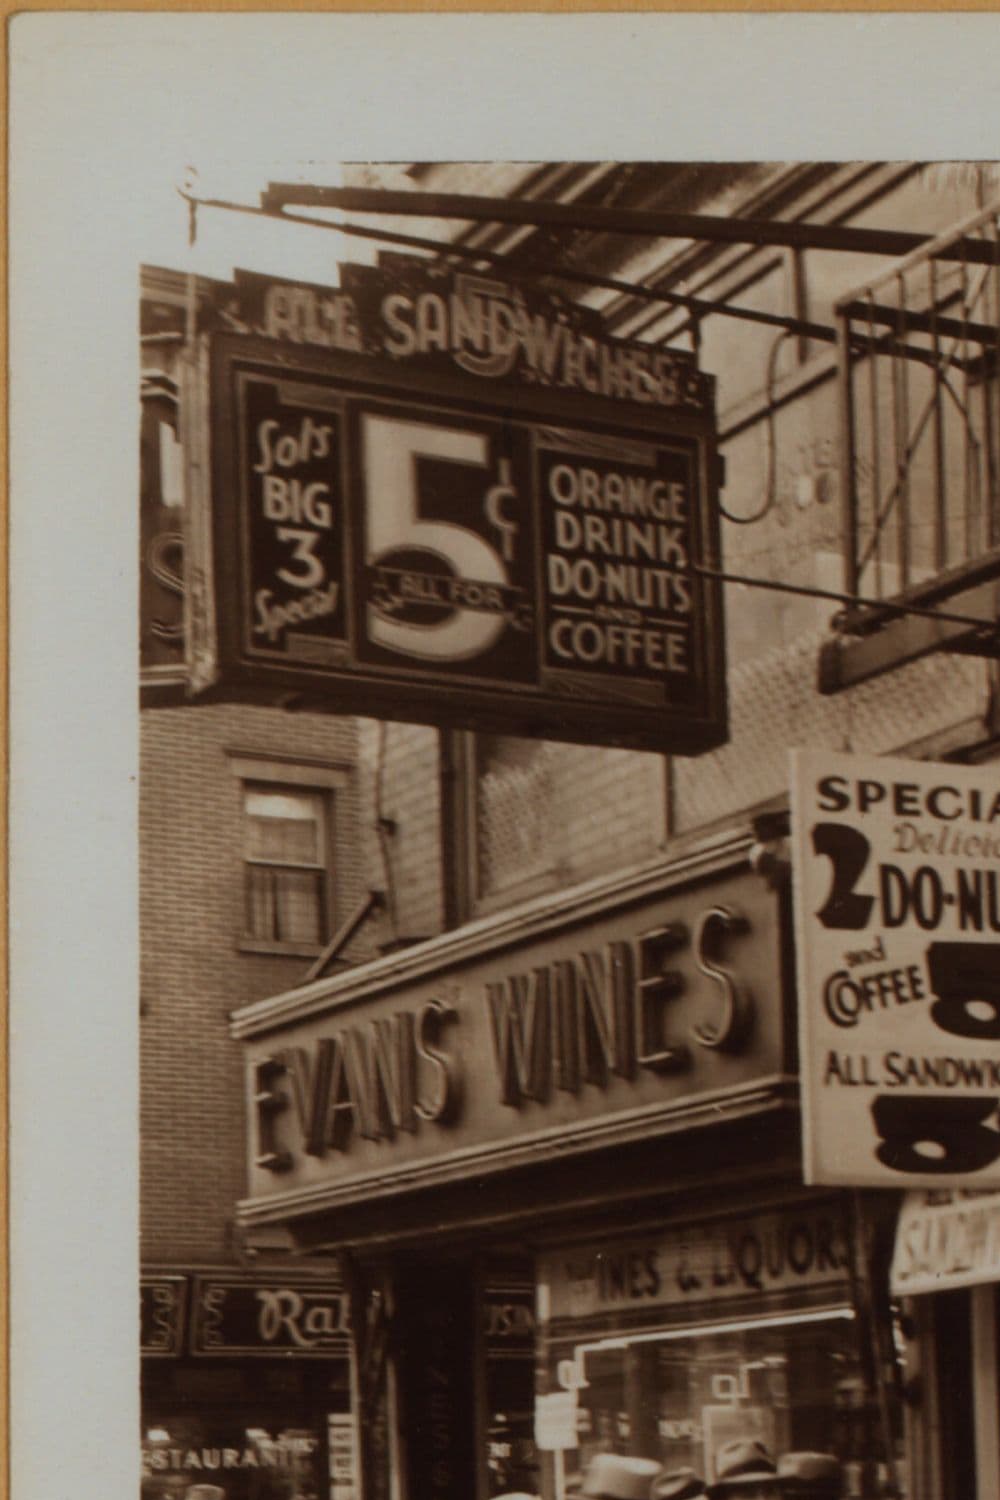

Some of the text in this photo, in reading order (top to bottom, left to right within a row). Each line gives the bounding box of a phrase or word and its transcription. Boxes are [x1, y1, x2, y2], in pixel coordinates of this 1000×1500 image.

[262, 475, 333, 530] BIG
[547, 464, 687, 523] ORANGE
[275, 526, 326, 589] 3
[553, 509, 689, 569] DRINK
[547, 553, 692, 613] DO-NUTS
[548, 617, 688, 673] COFFEE
[811, 822, 876, 930] 2
[486, 902, 756, 1112] WINES
[823, 963, 927, 1029] COFFEE
[823, 1050, 879, 1088] ALL
